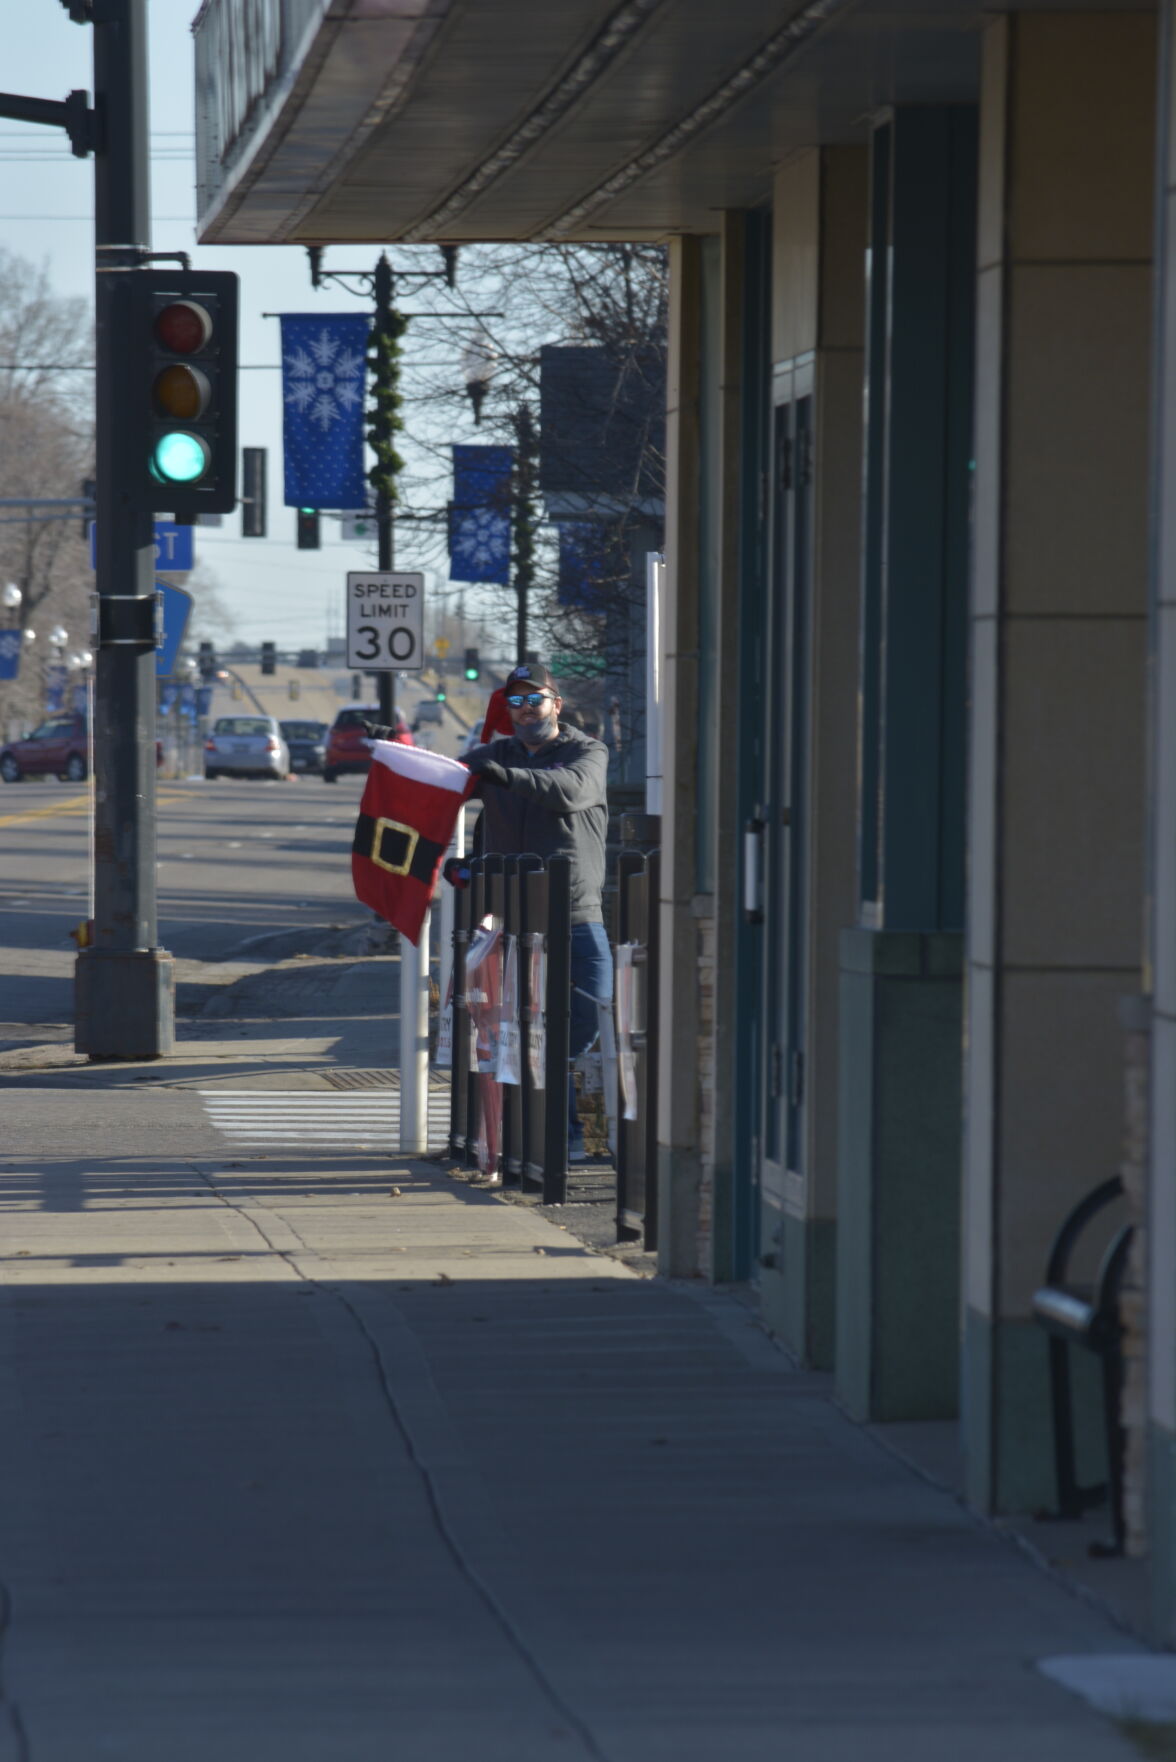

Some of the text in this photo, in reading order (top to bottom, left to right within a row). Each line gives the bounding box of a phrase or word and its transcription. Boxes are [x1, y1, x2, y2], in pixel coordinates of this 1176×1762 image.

[354, 584, 417, 598] SPEED
[360, 604, 409, 618] LIMIT
[355, 626, 416, 661] 30
